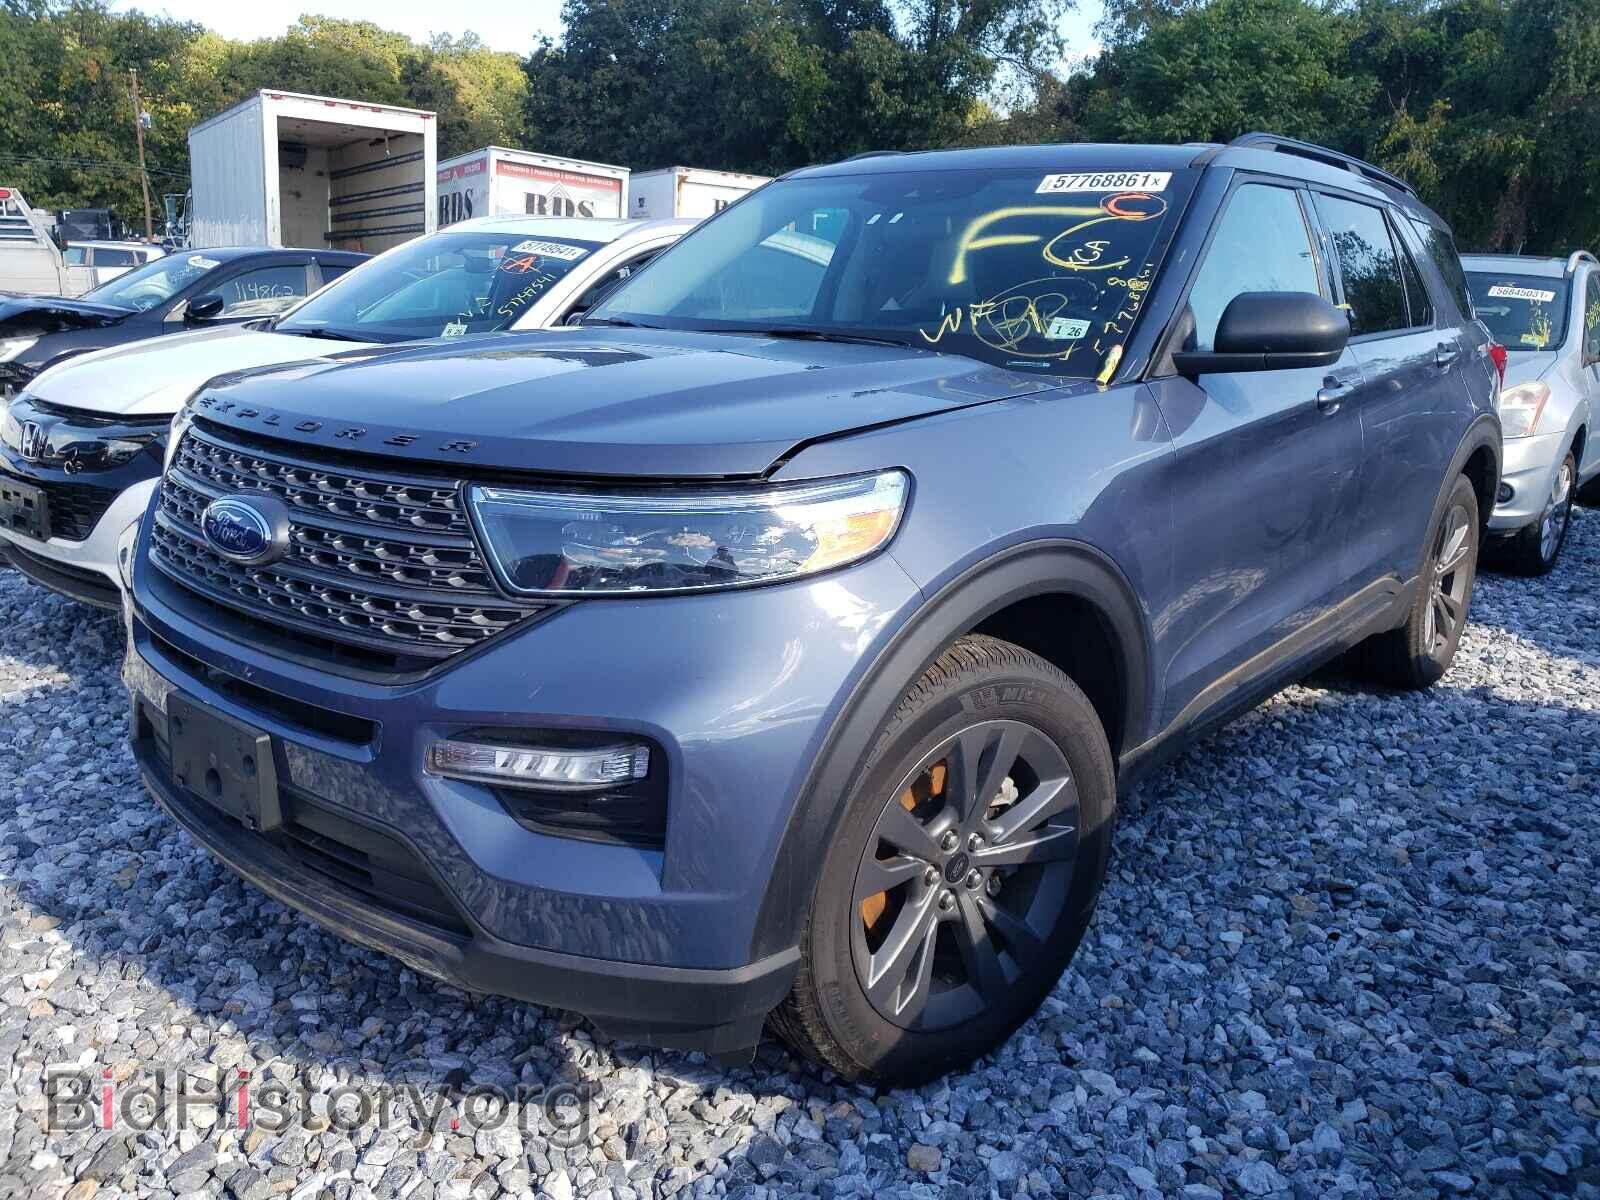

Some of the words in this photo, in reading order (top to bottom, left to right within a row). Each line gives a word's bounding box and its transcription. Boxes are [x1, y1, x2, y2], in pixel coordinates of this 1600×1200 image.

[439, 187, 474, 226] BDS
[1055, 325, 1062, 335] 1
[1067, 326, 1083, 338] 26
[200, 398, 480, 453] EXPLORER
[204, 510, 250, 547] Ford
